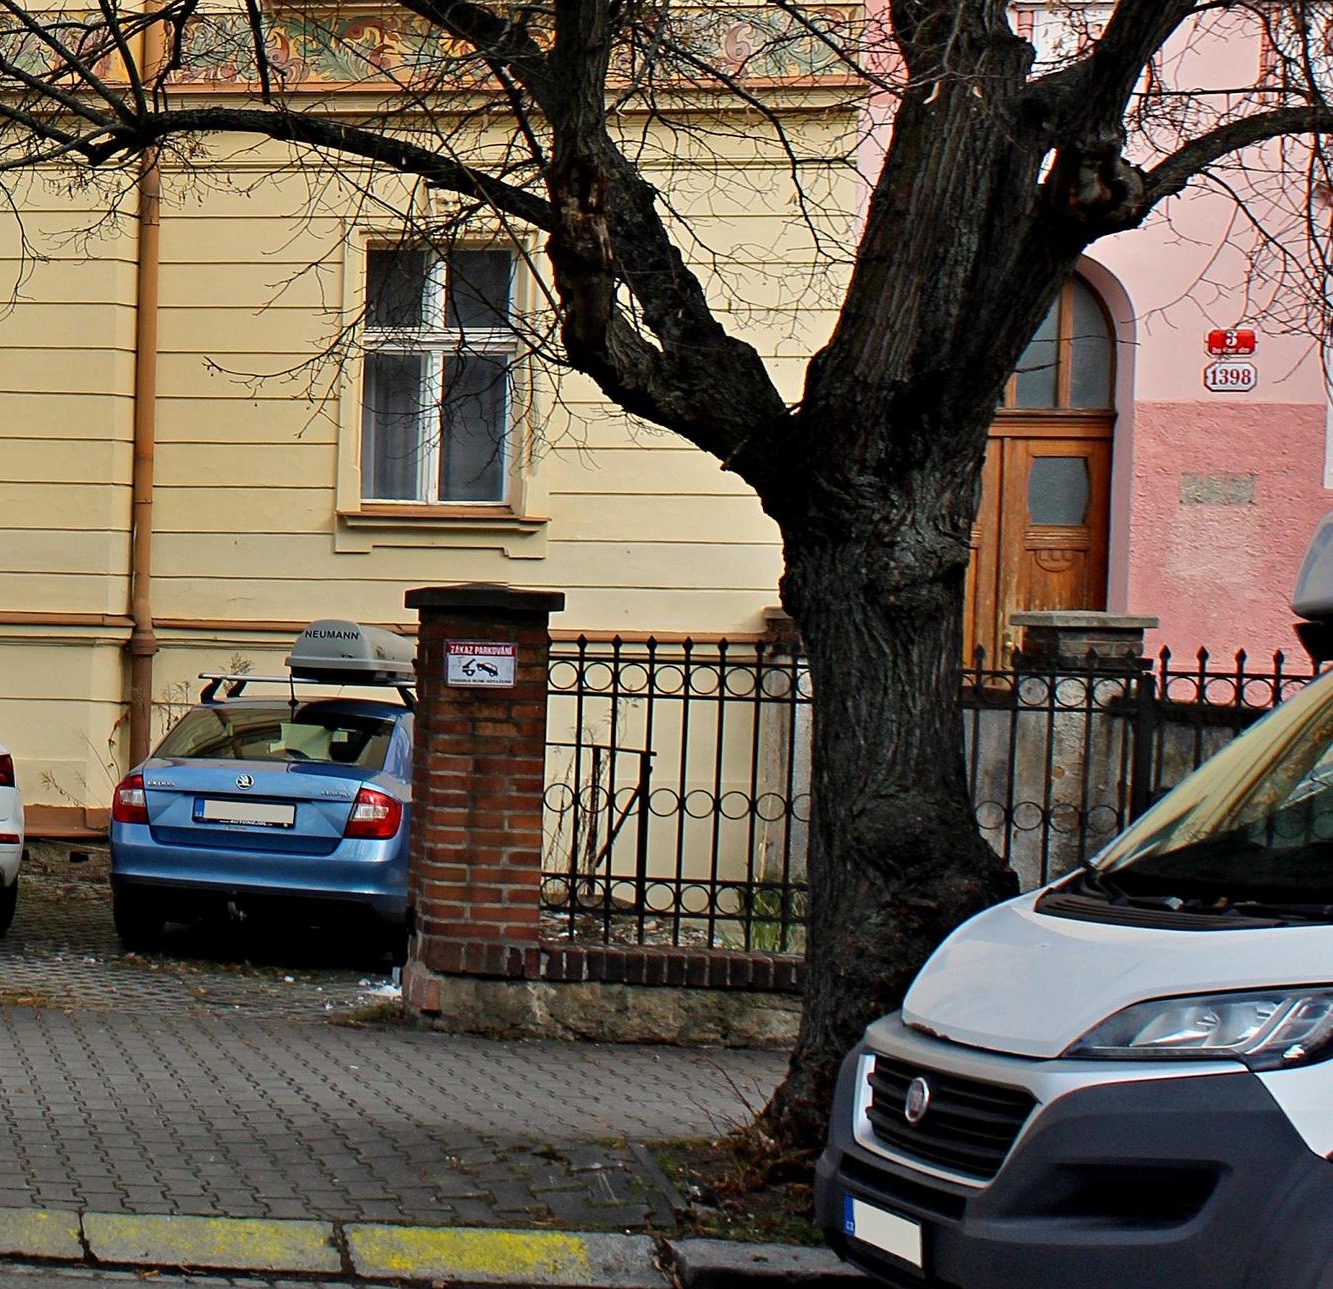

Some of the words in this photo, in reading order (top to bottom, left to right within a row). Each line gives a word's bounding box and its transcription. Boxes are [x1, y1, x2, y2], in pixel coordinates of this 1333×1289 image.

[1210, 368, 1251, 385] 1398
[304, 629, 359, 640] NEUMANN
[449, 645, 474, 654] ZÁKAZ
[475, 645, 513, 656] PARKOVÁNÍ
